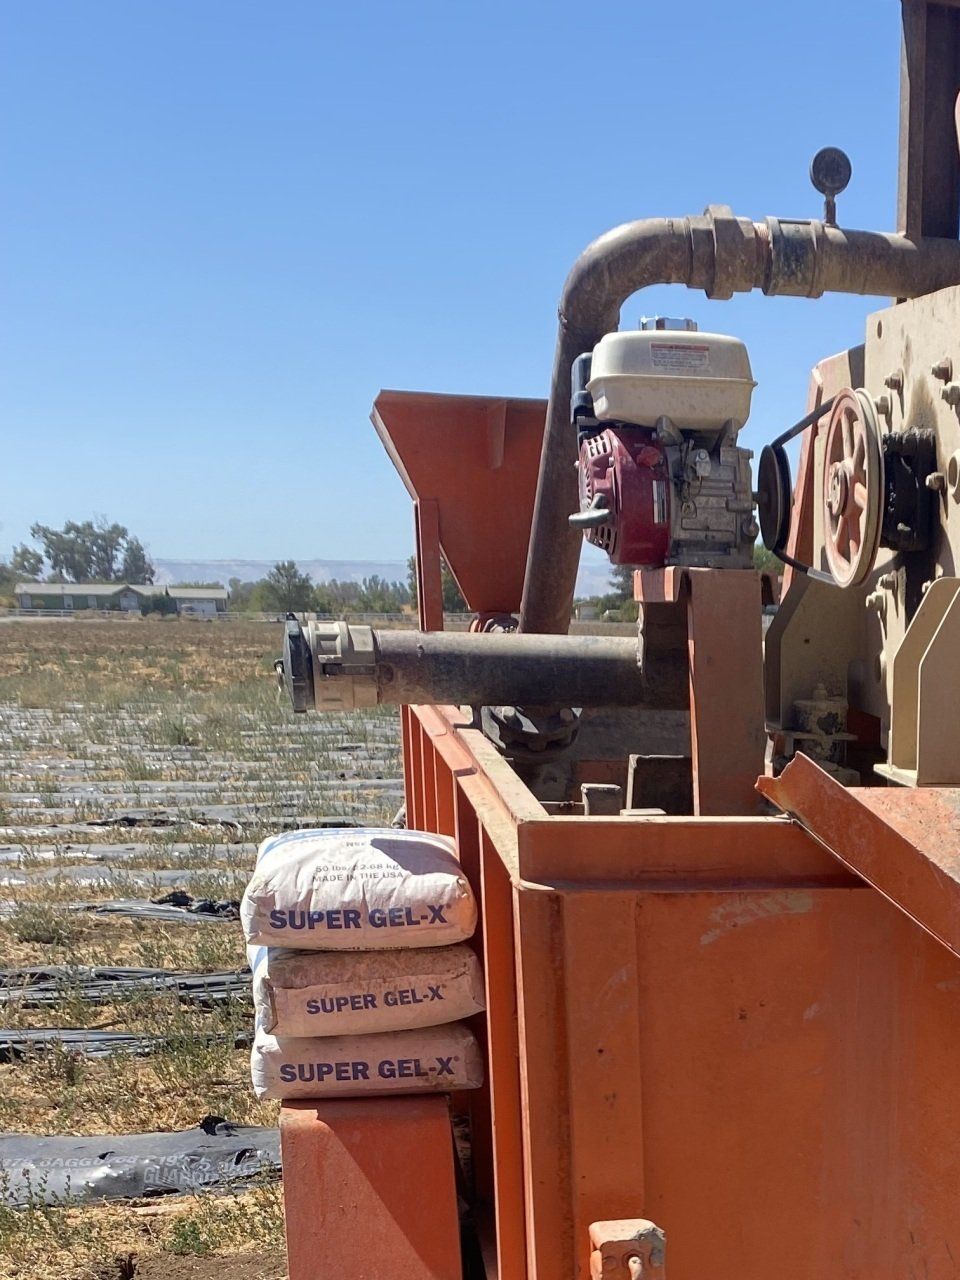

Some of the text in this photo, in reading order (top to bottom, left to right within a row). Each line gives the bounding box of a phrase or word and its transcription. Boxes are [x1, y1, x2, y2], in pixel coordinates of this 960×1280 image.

[312, 874, 344, 883] MADE
[360, 872, 379, 880] THE
[382, 871, 404, 879] USA
[269, 908, 362, 931] SUPER
[306, 994, 378, 1016] SUPER
[279, 1060, 370, 1083] SUPER
